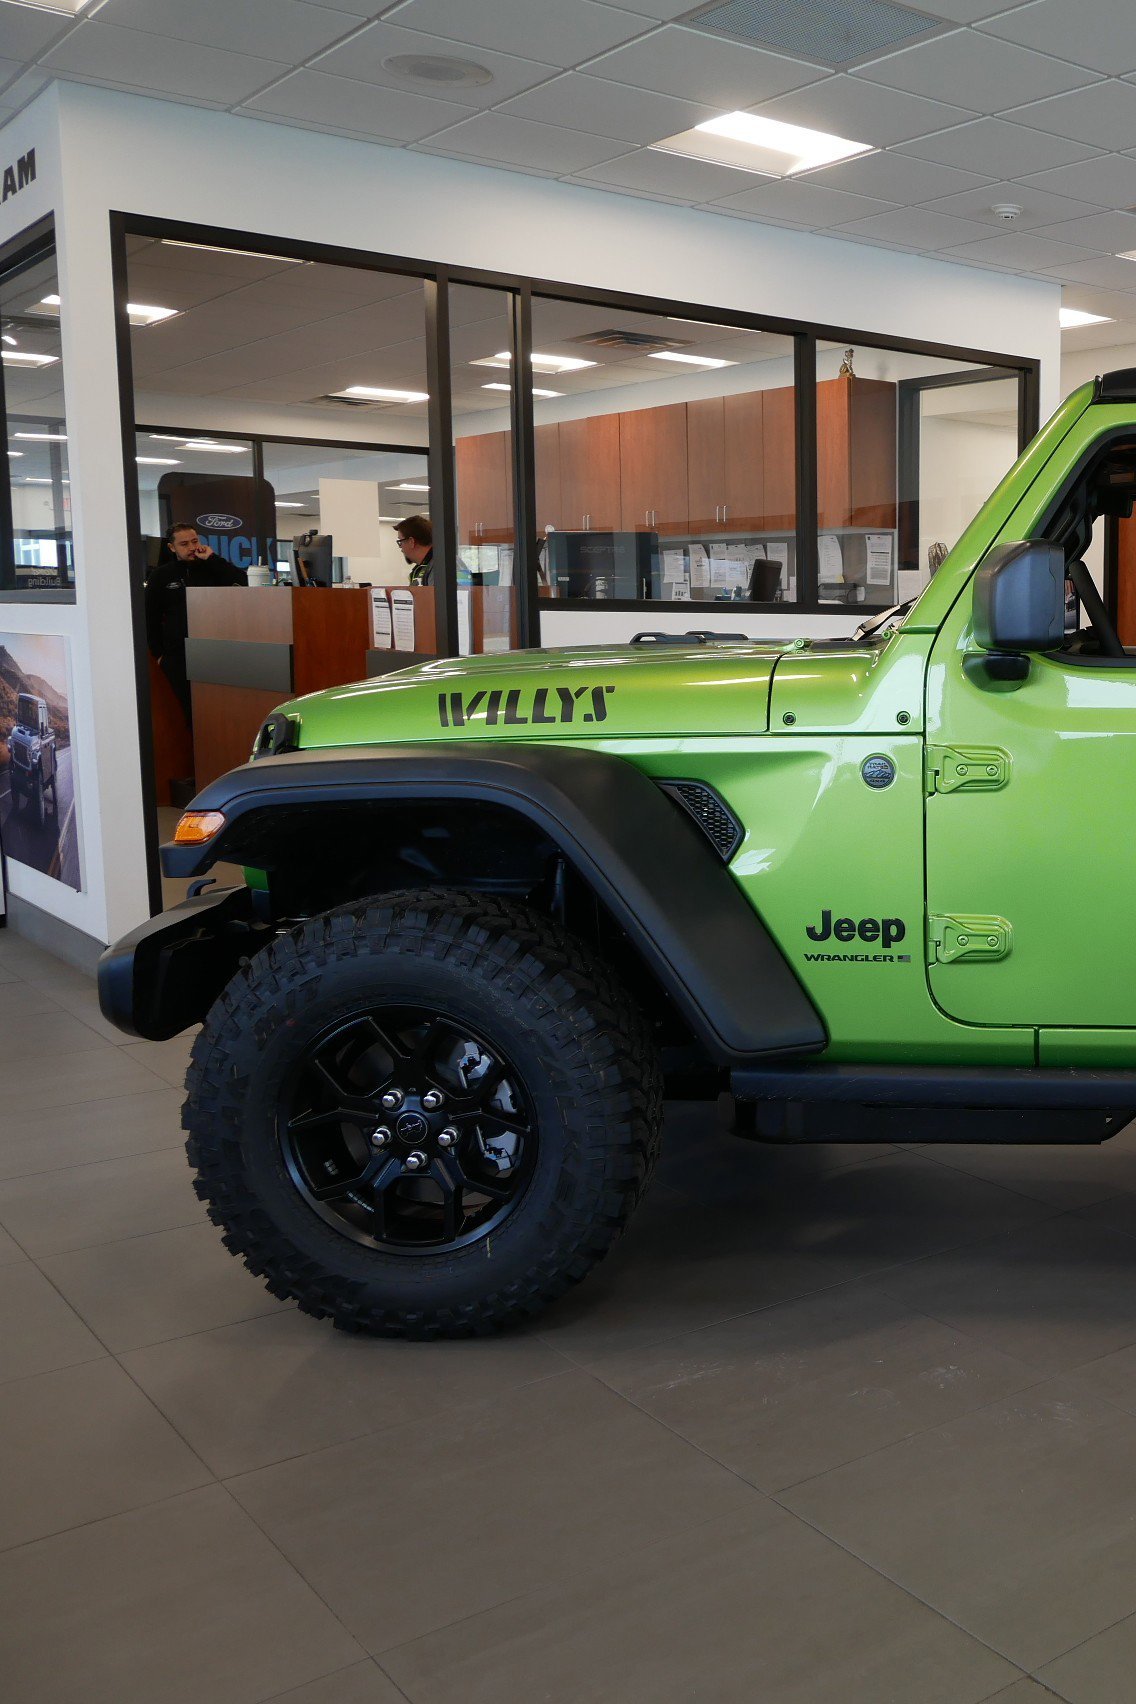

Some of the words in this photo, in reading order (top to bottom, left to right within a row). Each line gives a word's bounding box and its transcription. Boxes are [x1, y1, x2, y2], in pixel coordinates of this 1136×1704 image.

[0, 147, 36, 204] AM
[438, 686, 615, 727] WILLYS
[806, 909, 906, 948] Jeep
[803, 953, 895, 963] WRANGLER
